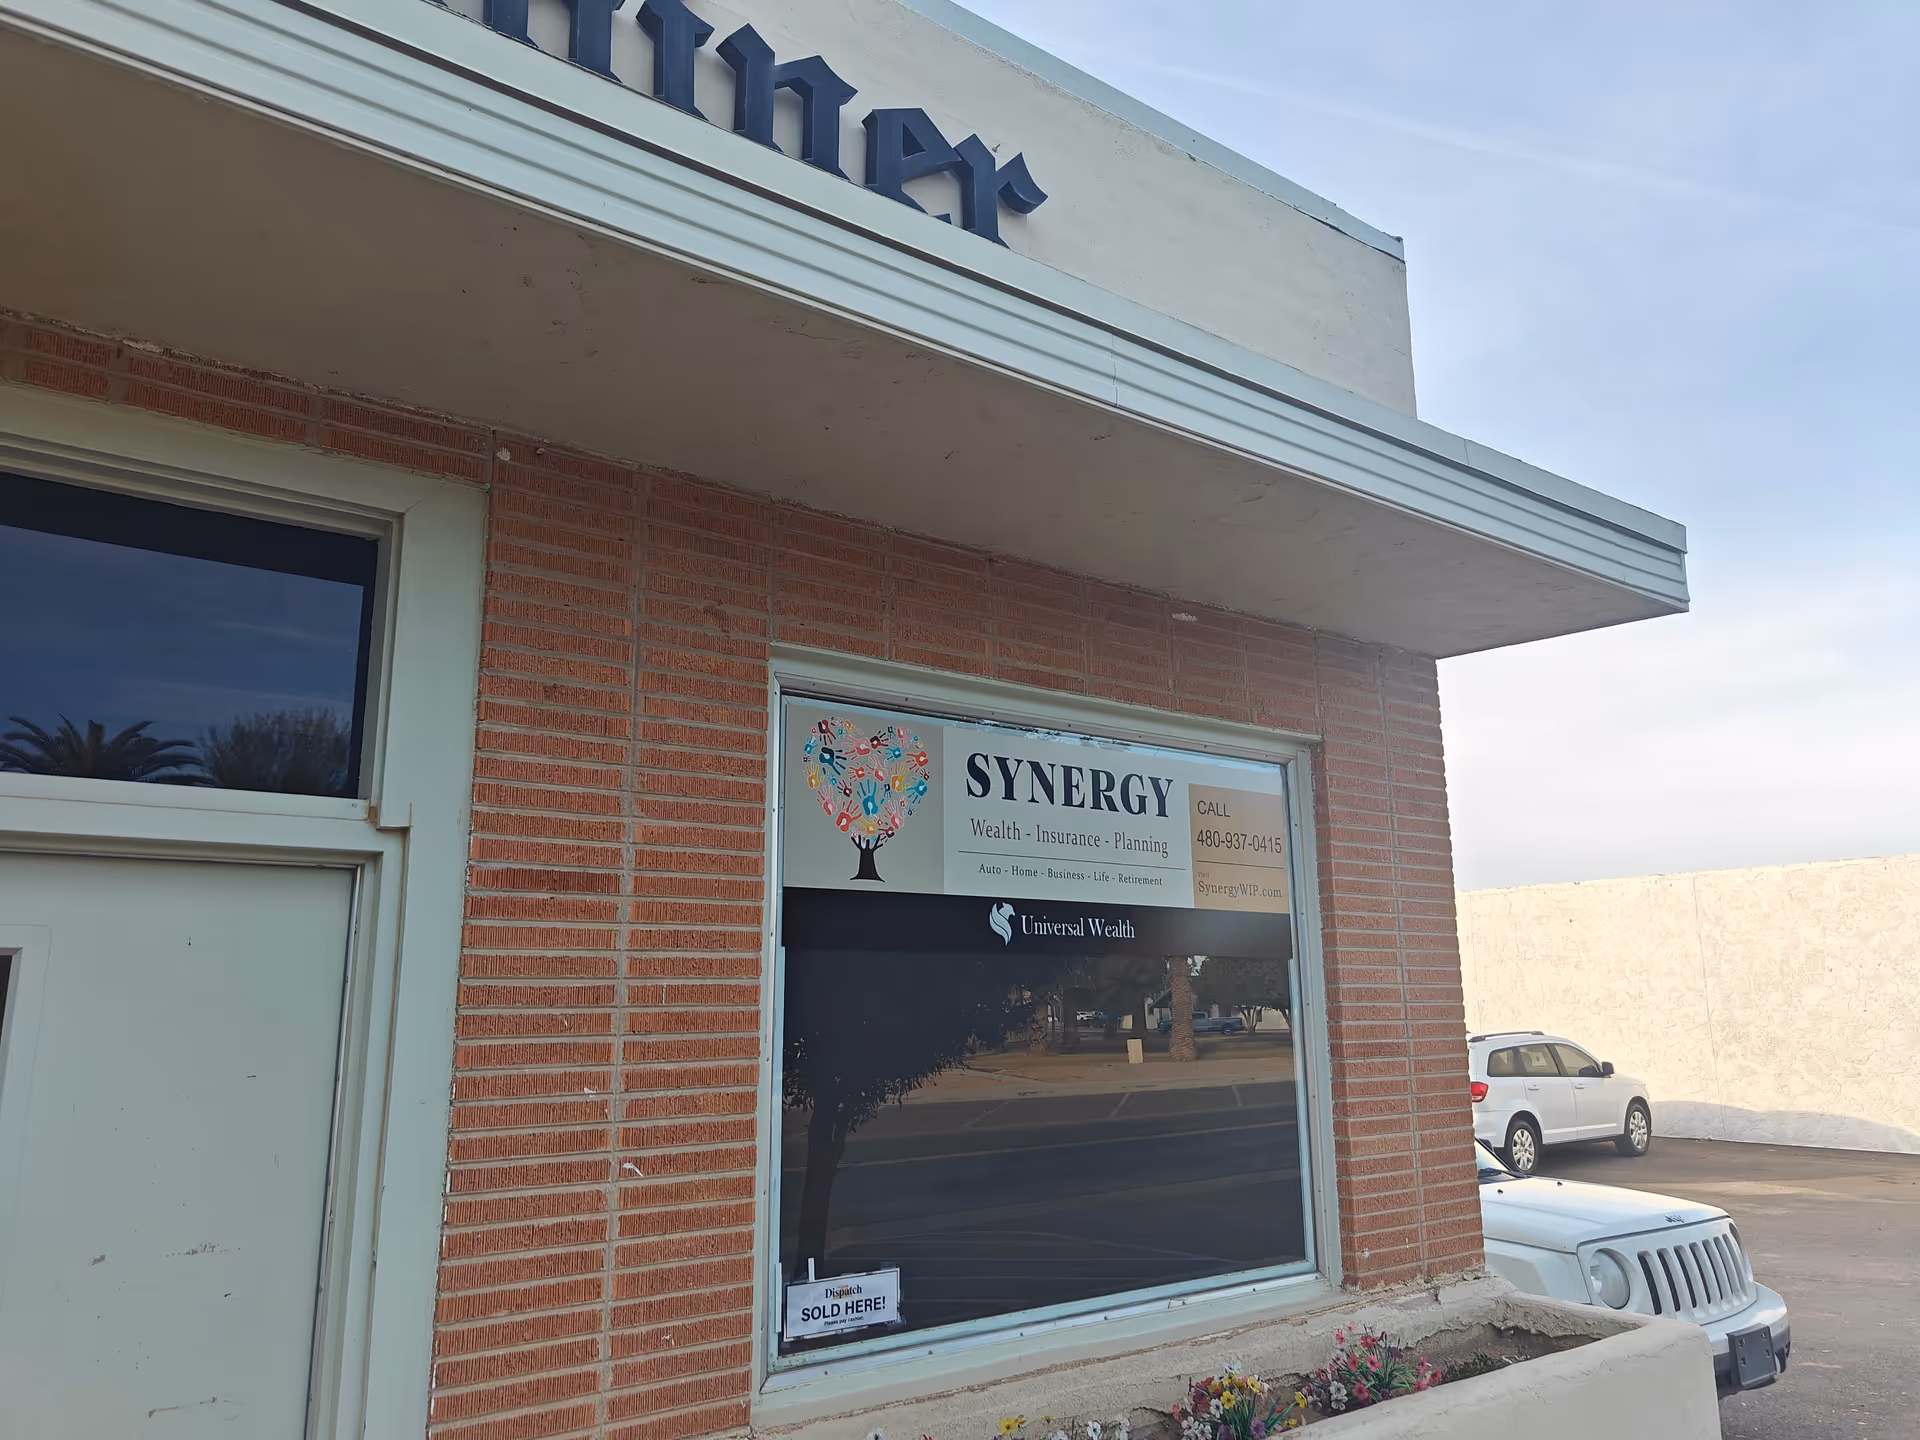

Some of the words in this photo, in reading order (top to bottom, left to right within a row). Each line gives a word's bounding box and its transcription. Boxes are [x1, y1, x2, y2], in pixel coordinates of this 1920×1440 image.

[966, 752, 1174, 818] SYNERGY
[1197, 800, 1231, 817] CALL
[970, 818, 1021, 840] Wealth
[1036, 824, 1100, 847] Insurance
[1114, 832, 1169, 858] Planning
[1196, 829, 1282, 853] 480-937-0415
[978, 863, 1002, 875] Auto
[1011, 865, 1038, 877] Home
[1047, 867, 1085, 880] Business
[1093, 871, 1110, 882] Life
[1118, 873, 1163, 886] Retirement
[1198, 880, 1282, 898] SynergyWIP.com
[1021, 914, 1084, 937] Universal
[1088, 918, 1135, 938] Wealth
[825, 1284, 862, 1299] Dispatch
[801, 1303, 840, 1321] SOLD
[845, 1296, 886, 1315] HERE!
